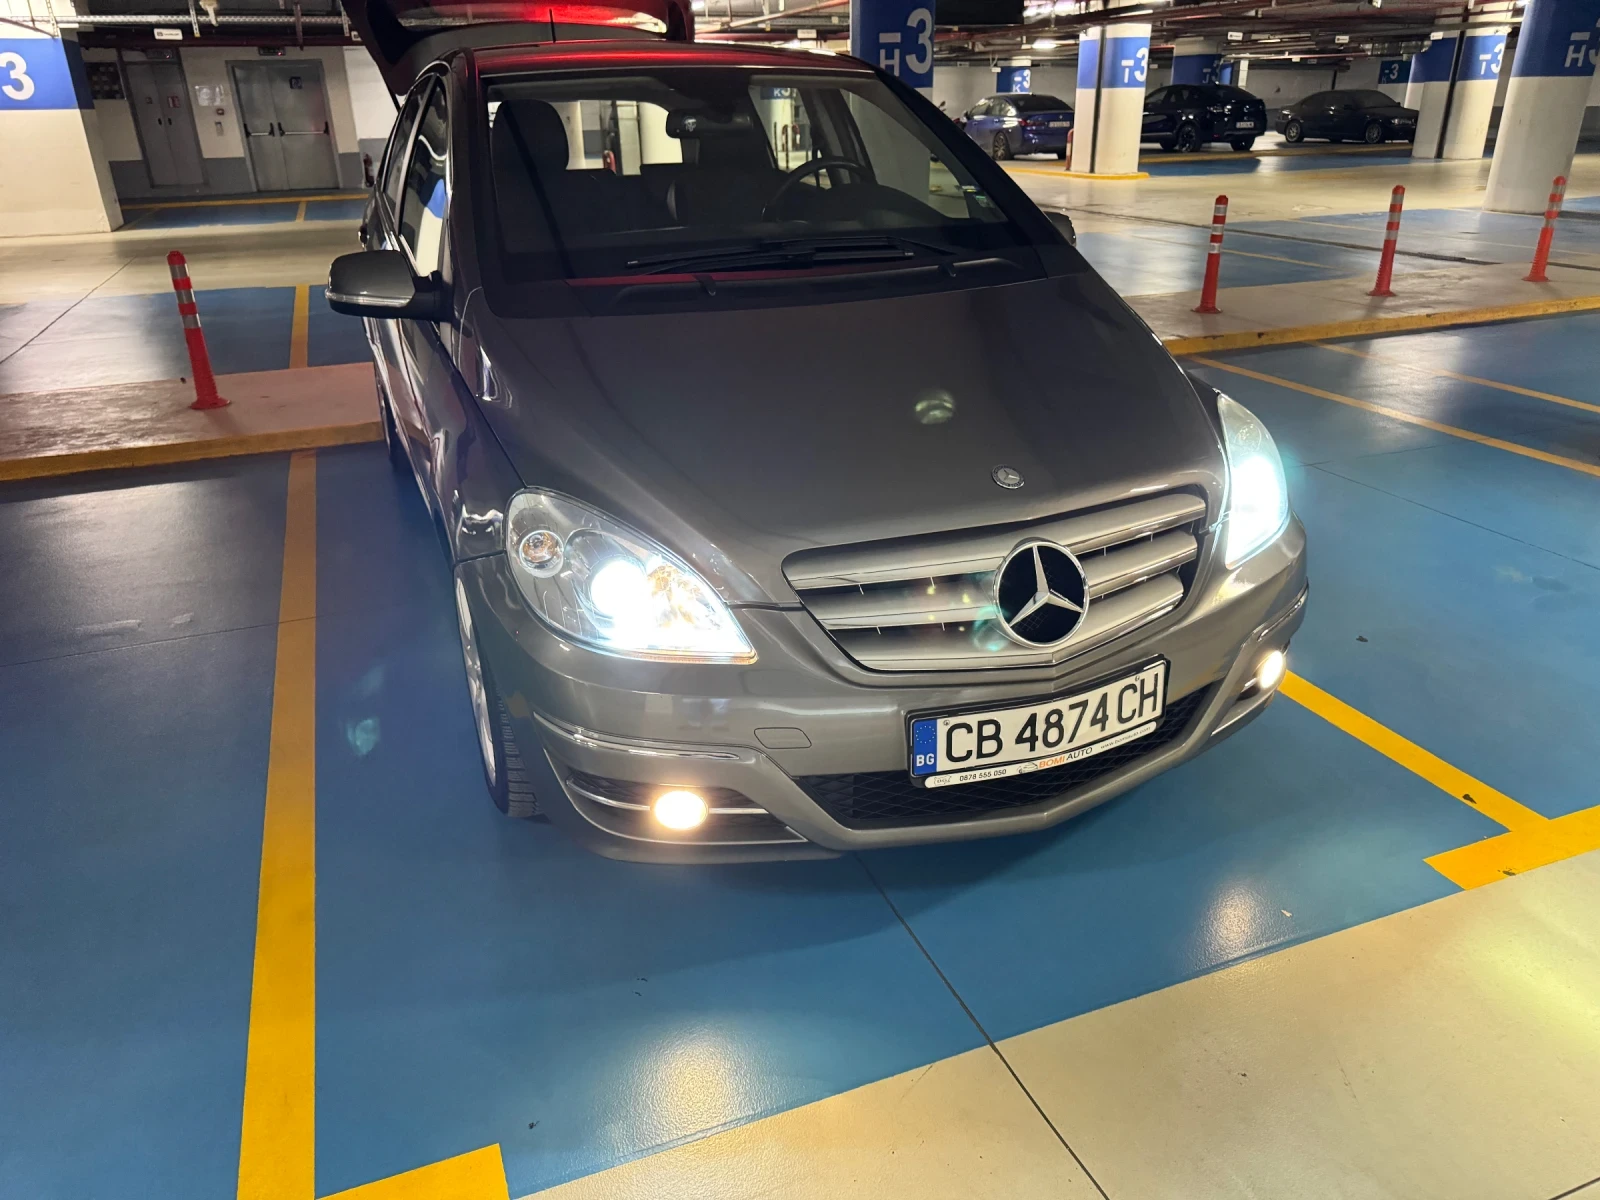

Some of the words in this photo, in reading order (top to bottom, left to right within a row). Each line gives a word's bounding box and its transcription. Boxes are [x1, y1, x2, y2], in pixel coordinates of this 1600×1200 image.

[0, 51, 35, 101] 3
[944, 718, 1004, 764] CB
[1015, 692, 1109, 752] 4874
[1117, 672, 1159, 724] CH
[916, 753, 935, 767] BG
[1039, 755, 1065, 769] BOMI
[1066, 747, 1093, 762] AUTO
[959, 773, 977, 782] 0878
[978, 771, 992, 779] 555
[993, 769, 1007, 777] 050
